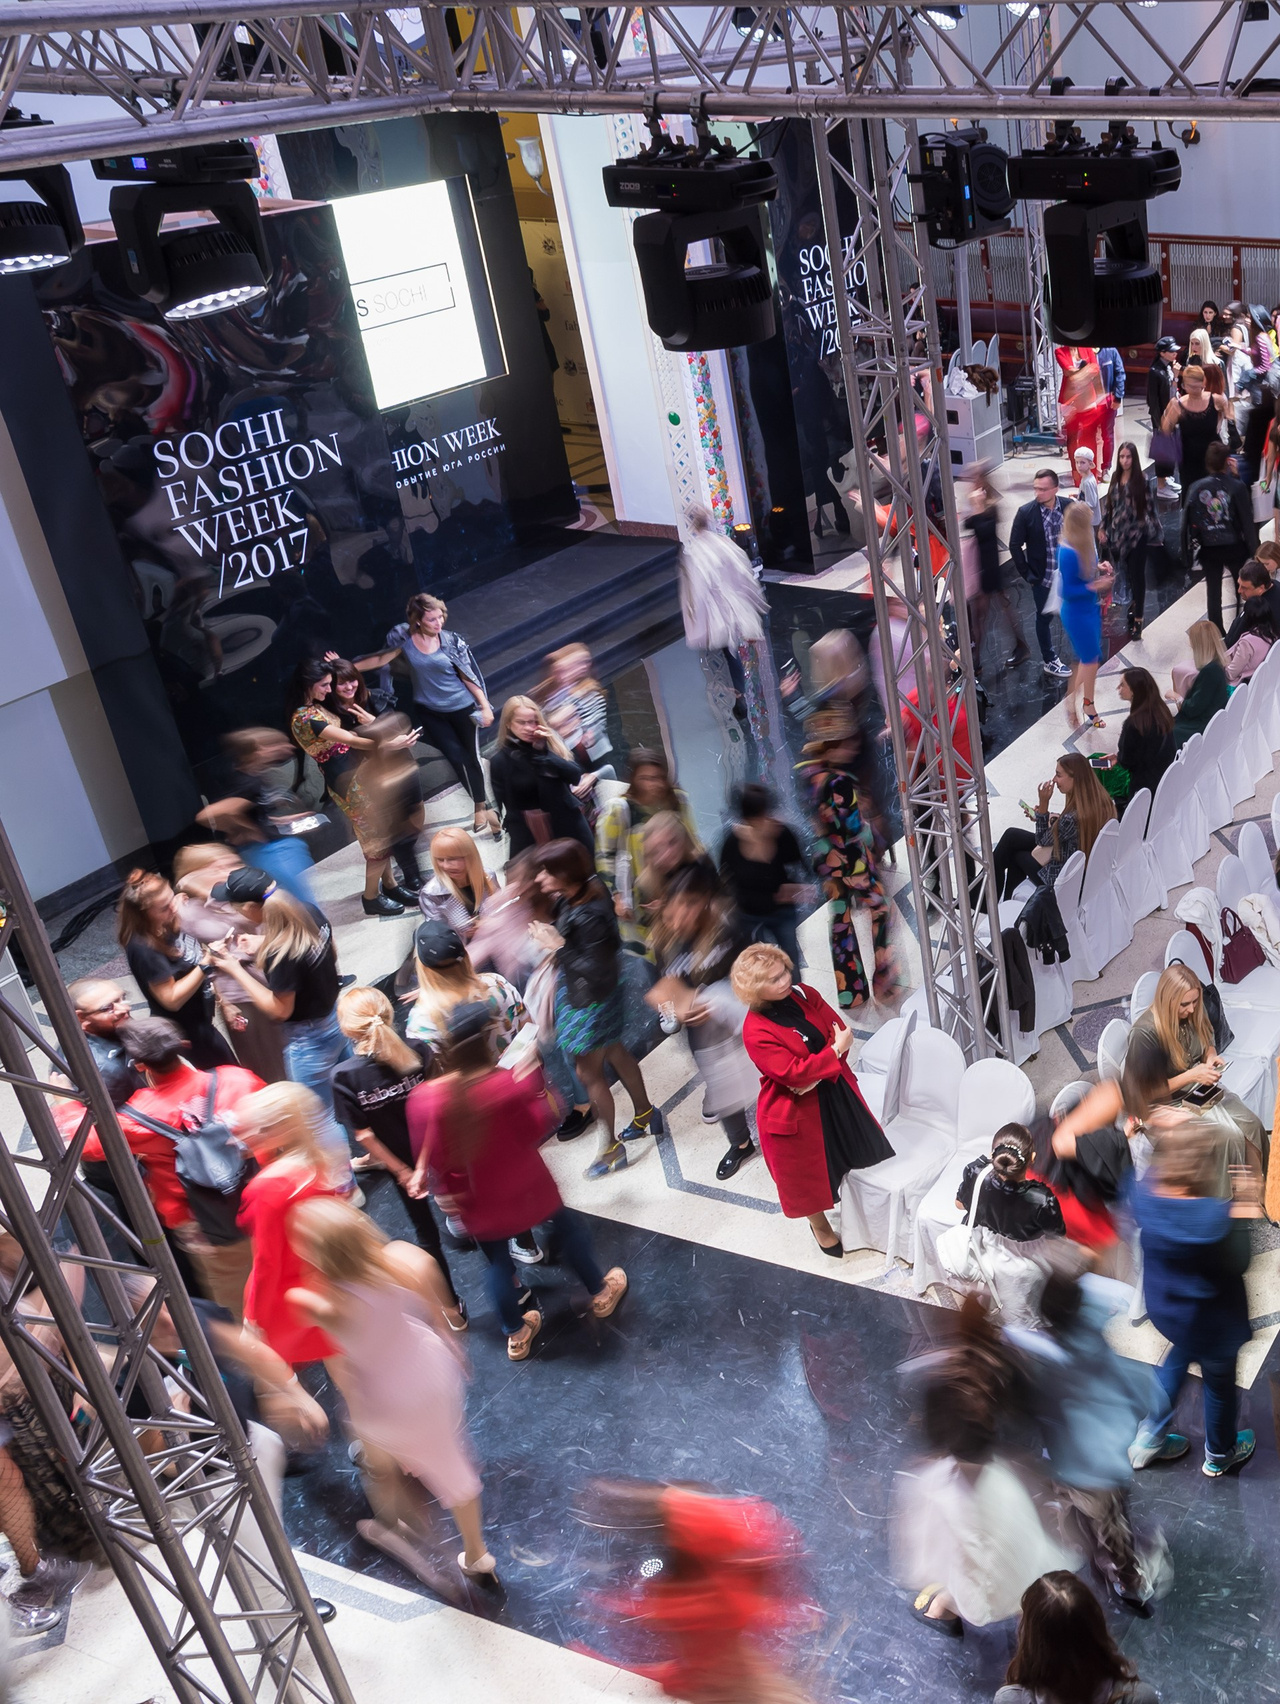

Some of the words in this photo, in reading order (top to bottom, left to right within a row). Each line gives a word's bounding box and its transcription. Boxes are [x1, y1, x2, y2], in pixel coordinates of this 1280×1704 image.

[373, 283, 428, 314] SOCHI
[805, 291, 859, 331] WEK
[153, 408, 291, 479] SOCHI
[442, 417, 502, 453] WEEK
[442, 460, 463, 473] ЮГА
[468, 443, 506, 463] РОССИИ
[161, 432, 343, 521] FASHION
[173, 489, 305, 558] WEEK
[218, 527, 309, 599] /2017
